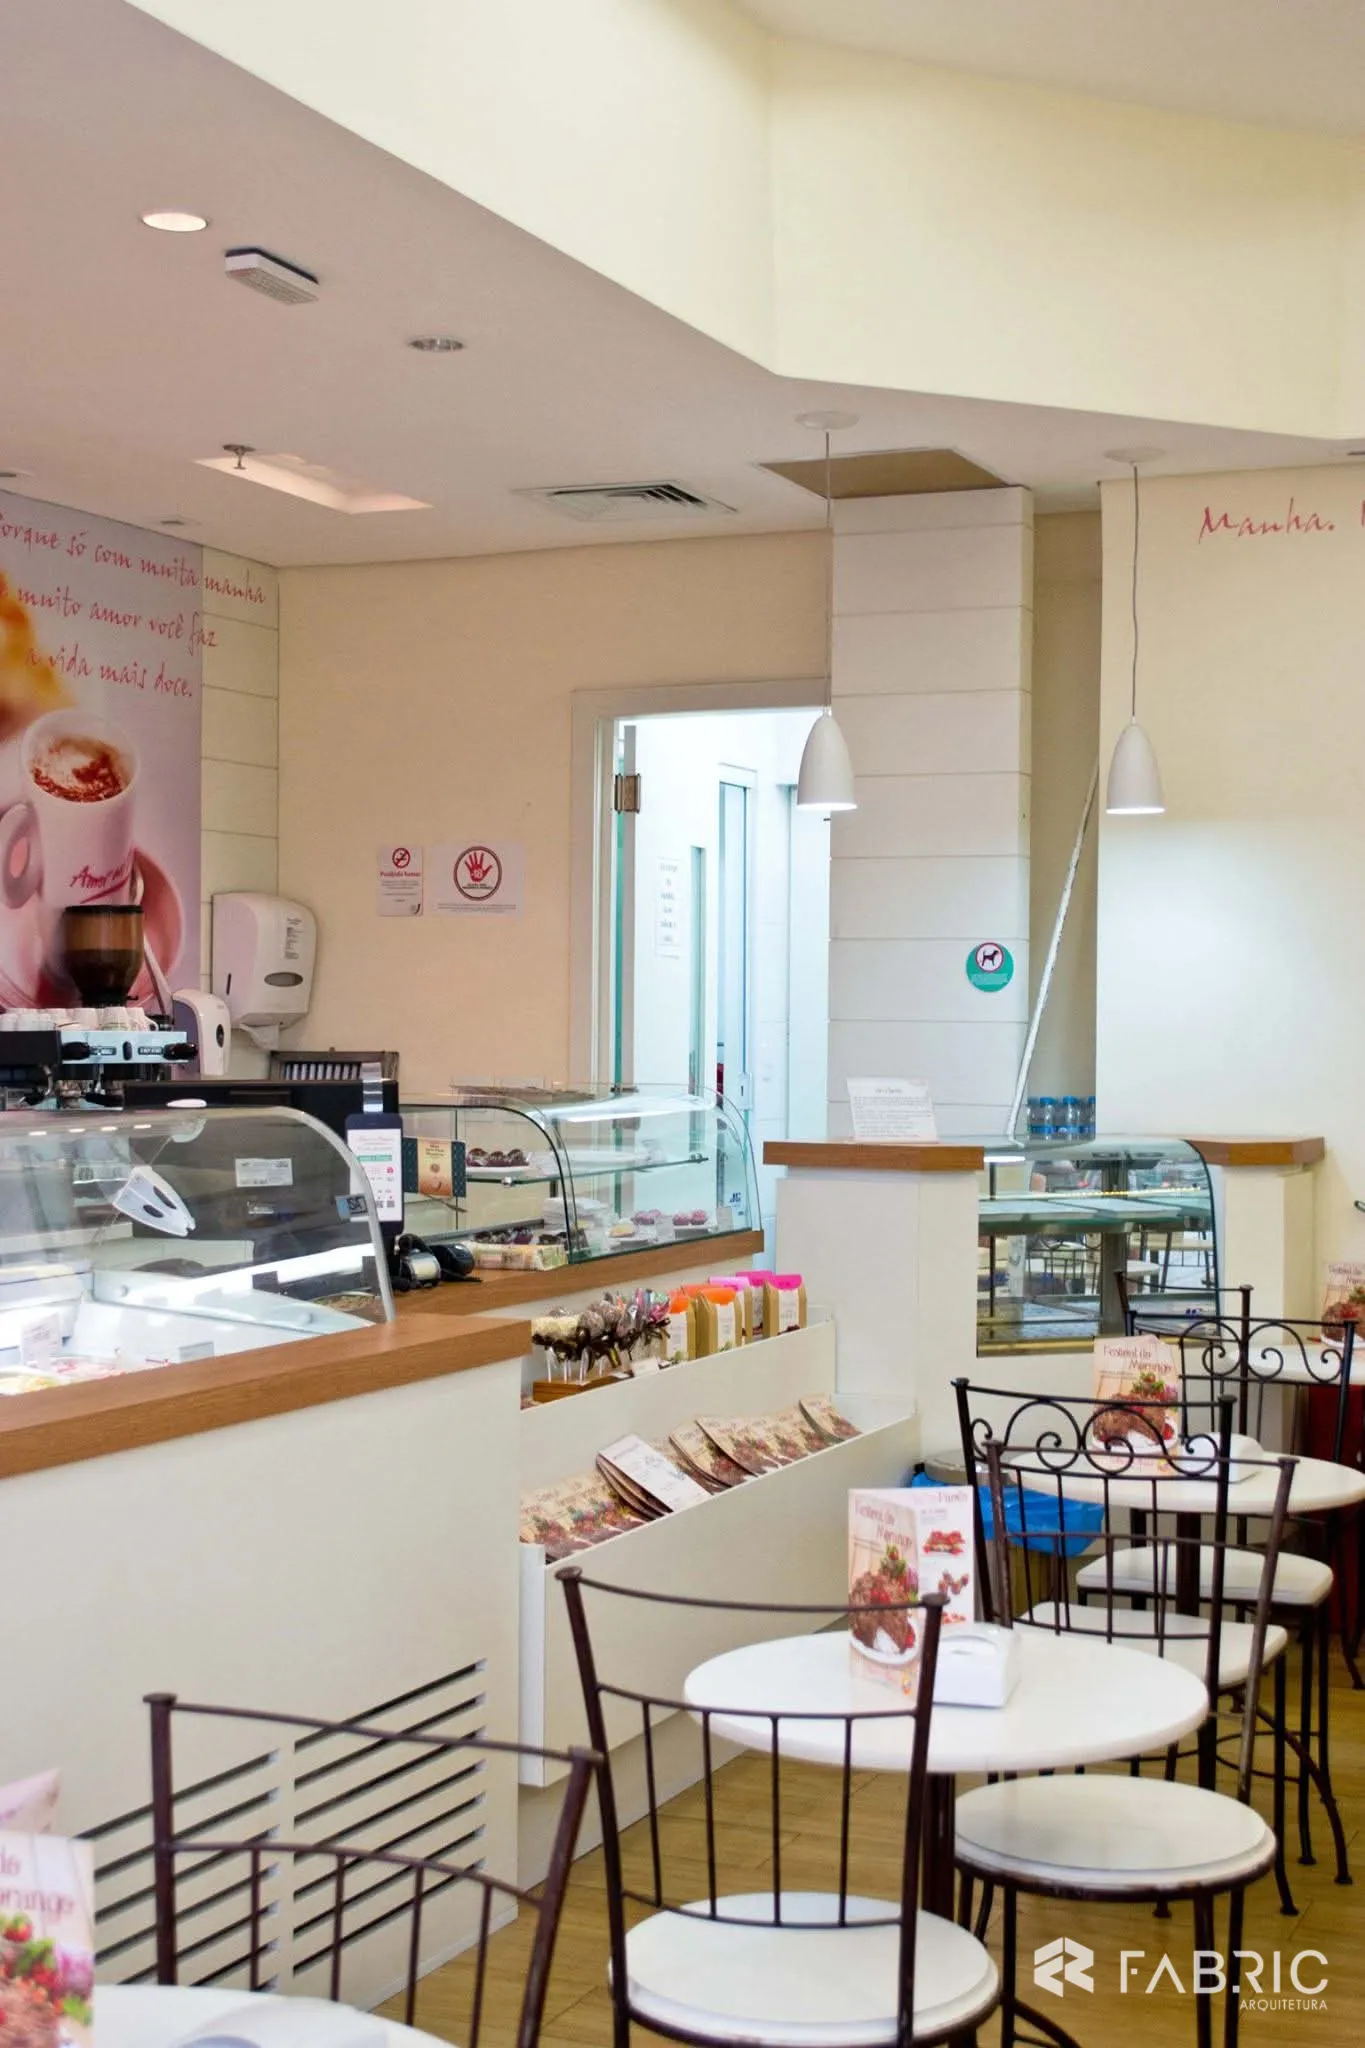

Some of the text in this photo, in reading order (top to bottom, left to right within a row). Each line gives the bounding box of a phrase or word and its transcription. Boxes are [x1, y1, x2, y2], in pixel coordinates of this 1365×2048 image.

[0, 511, 266, 604] orque só com muita manha
[17, 585, 83, 617] muito
[90, 602, 142, 627] amor
[149, 612, 184, 639] você
[188, 609, 217, 656] faz
[48, 643, 92, 678] vida
[100, 660, 147, 689] mais
